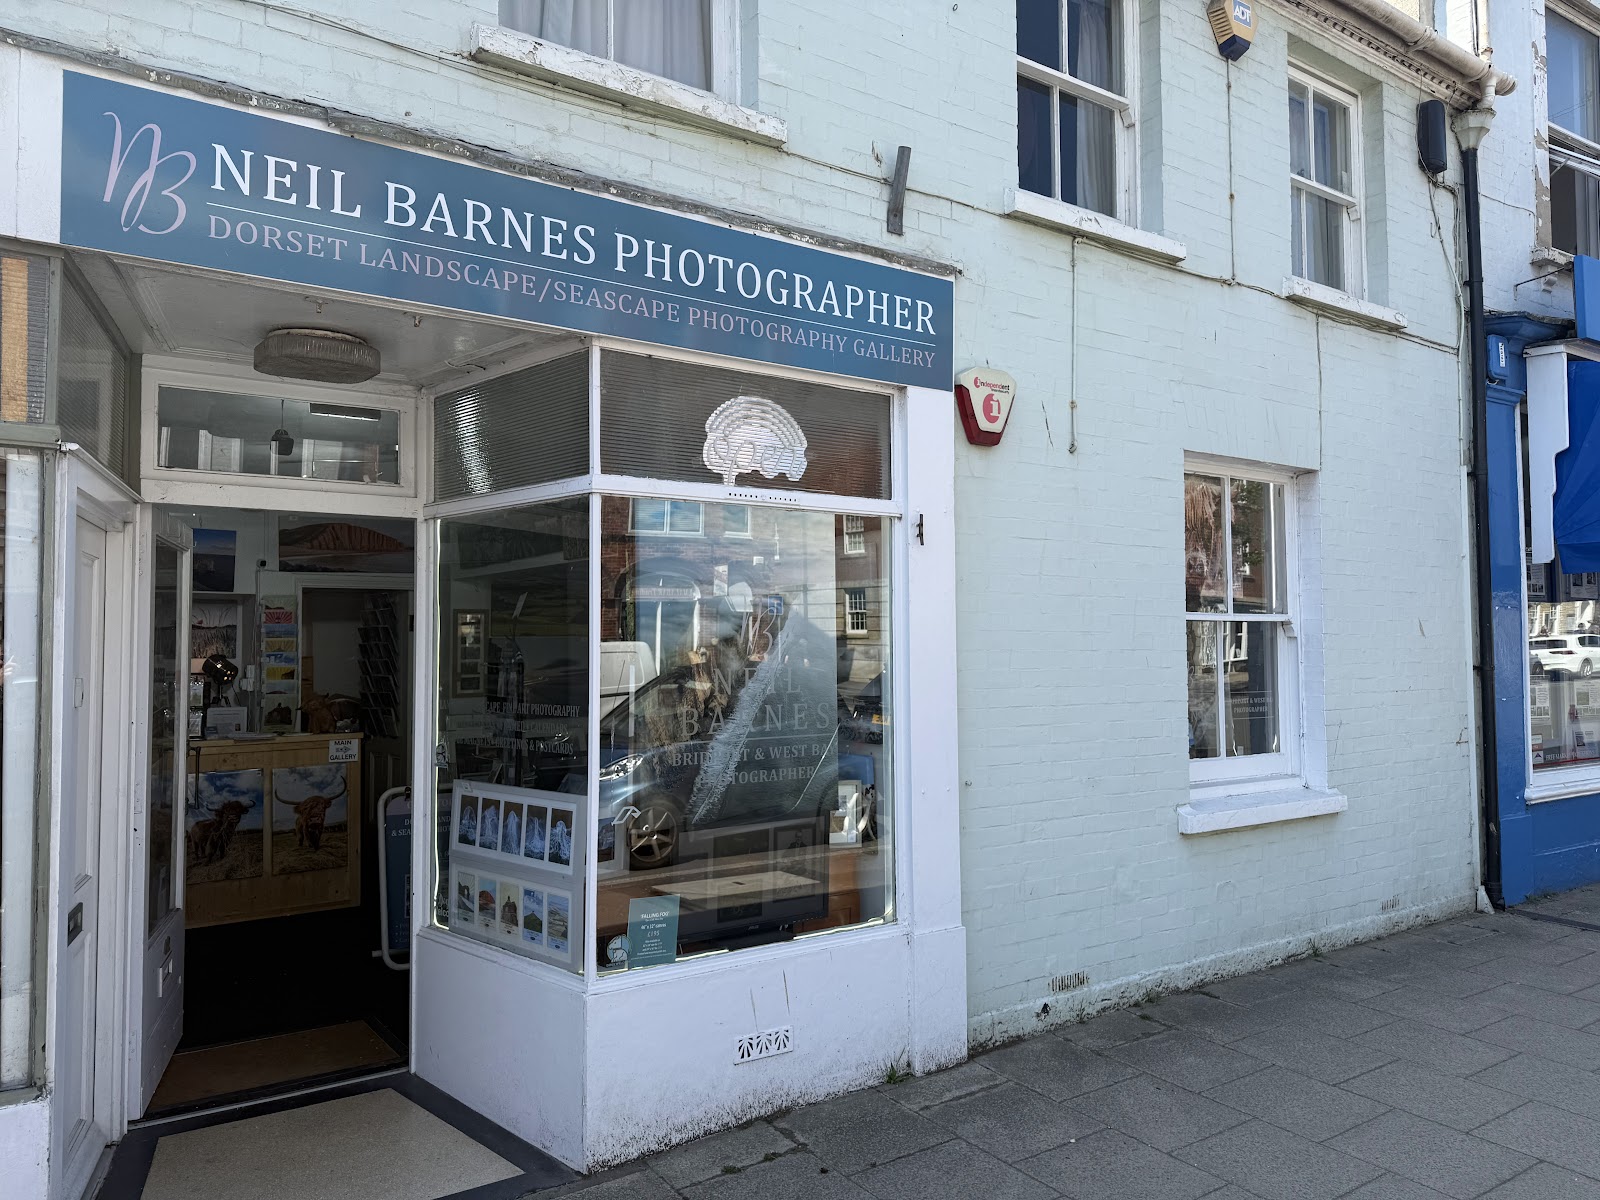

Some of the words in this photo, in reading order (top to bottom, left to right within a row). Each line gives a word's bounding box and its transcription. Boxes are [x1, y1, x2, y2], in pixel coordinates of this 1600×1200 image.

[1233, 4, 1251, 23] ADT
[210, 143, 362, 218] NEIL
[383, 181, 597, 265] BARNES
[613, 232, 937, 336] PHOTOGRAPHER
[207, 214, 348, 261] DORSET
[359, 243, 680, 323] LANDSCAPE/SEASCAPE
[688, 306, 848, 354] PHOTOGRAPHY
[853, 338, 936, 368] GALLERY
[516, 703, 530, 715] ART
[530, 703, 580, 718] PHOTOGRAPHY
[681, 702, 830, 737] BANES
[495, 737, 529, 750] GREETINGS
[529, 741, 535, 750] &
[535, 742, 574, 755] POSTCARDS
[754, 747, 766, 761] &
[769, 744, 808, 759] WEST
[329, 753, 357, 761] GALLERY
